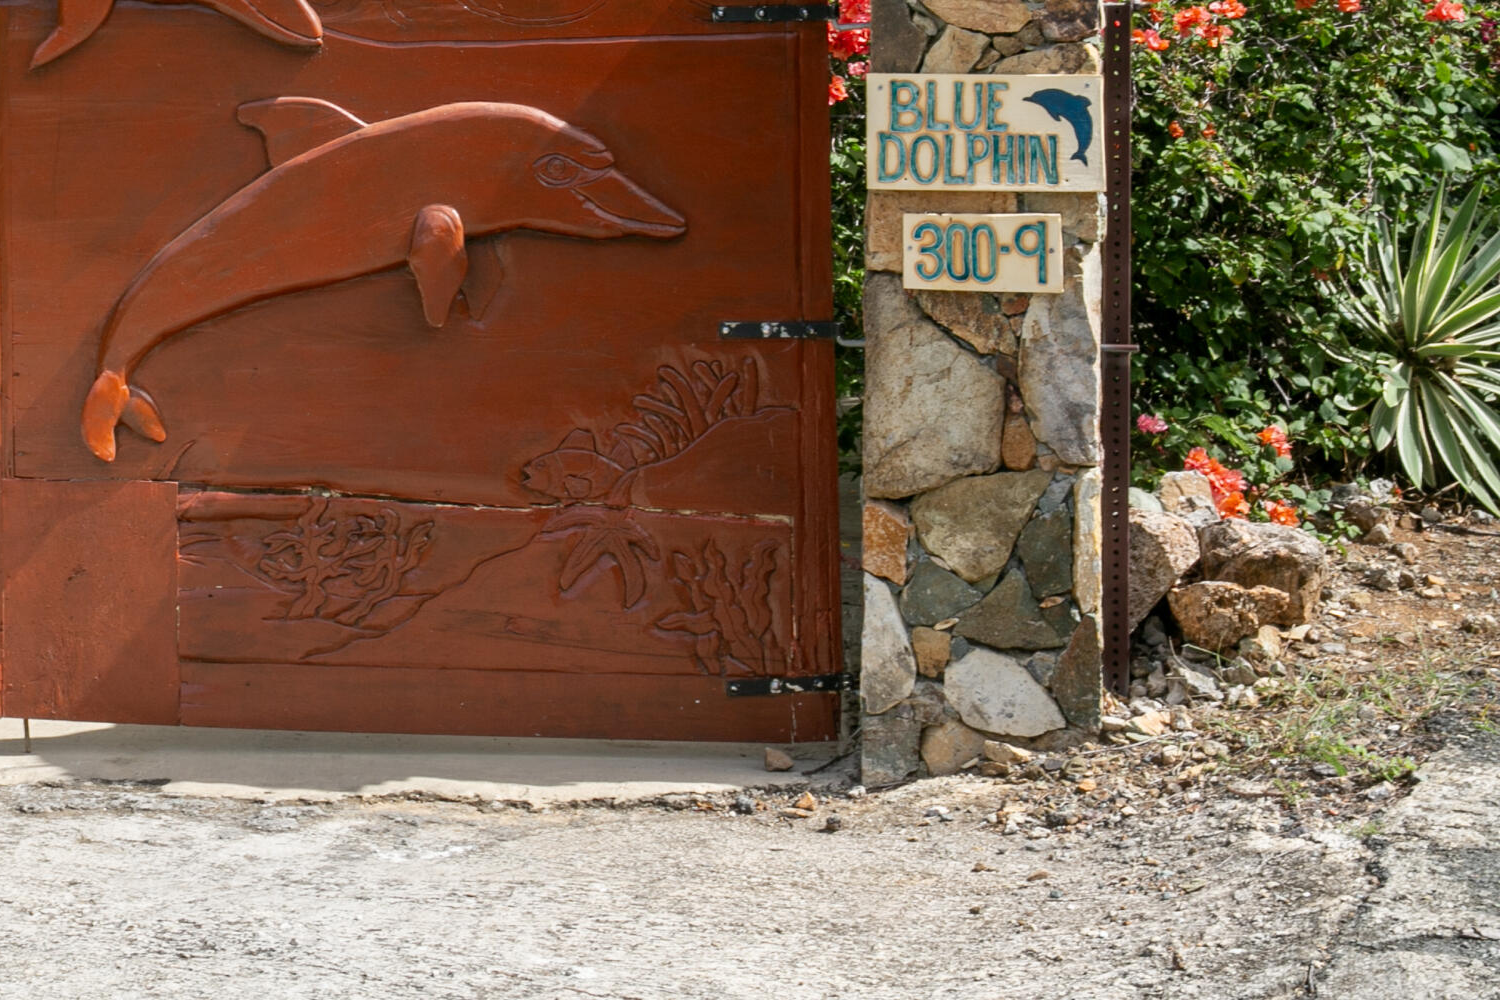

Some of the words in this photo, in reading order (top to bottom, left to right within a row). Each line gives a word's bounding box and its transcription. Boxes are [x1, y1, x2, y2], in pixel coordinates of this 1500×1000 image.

[890, 80, 1009, 133] BLUE
[877, 132, 1059, 185] DOLPHIN
[913, 221, 1048, 284] 300-9
